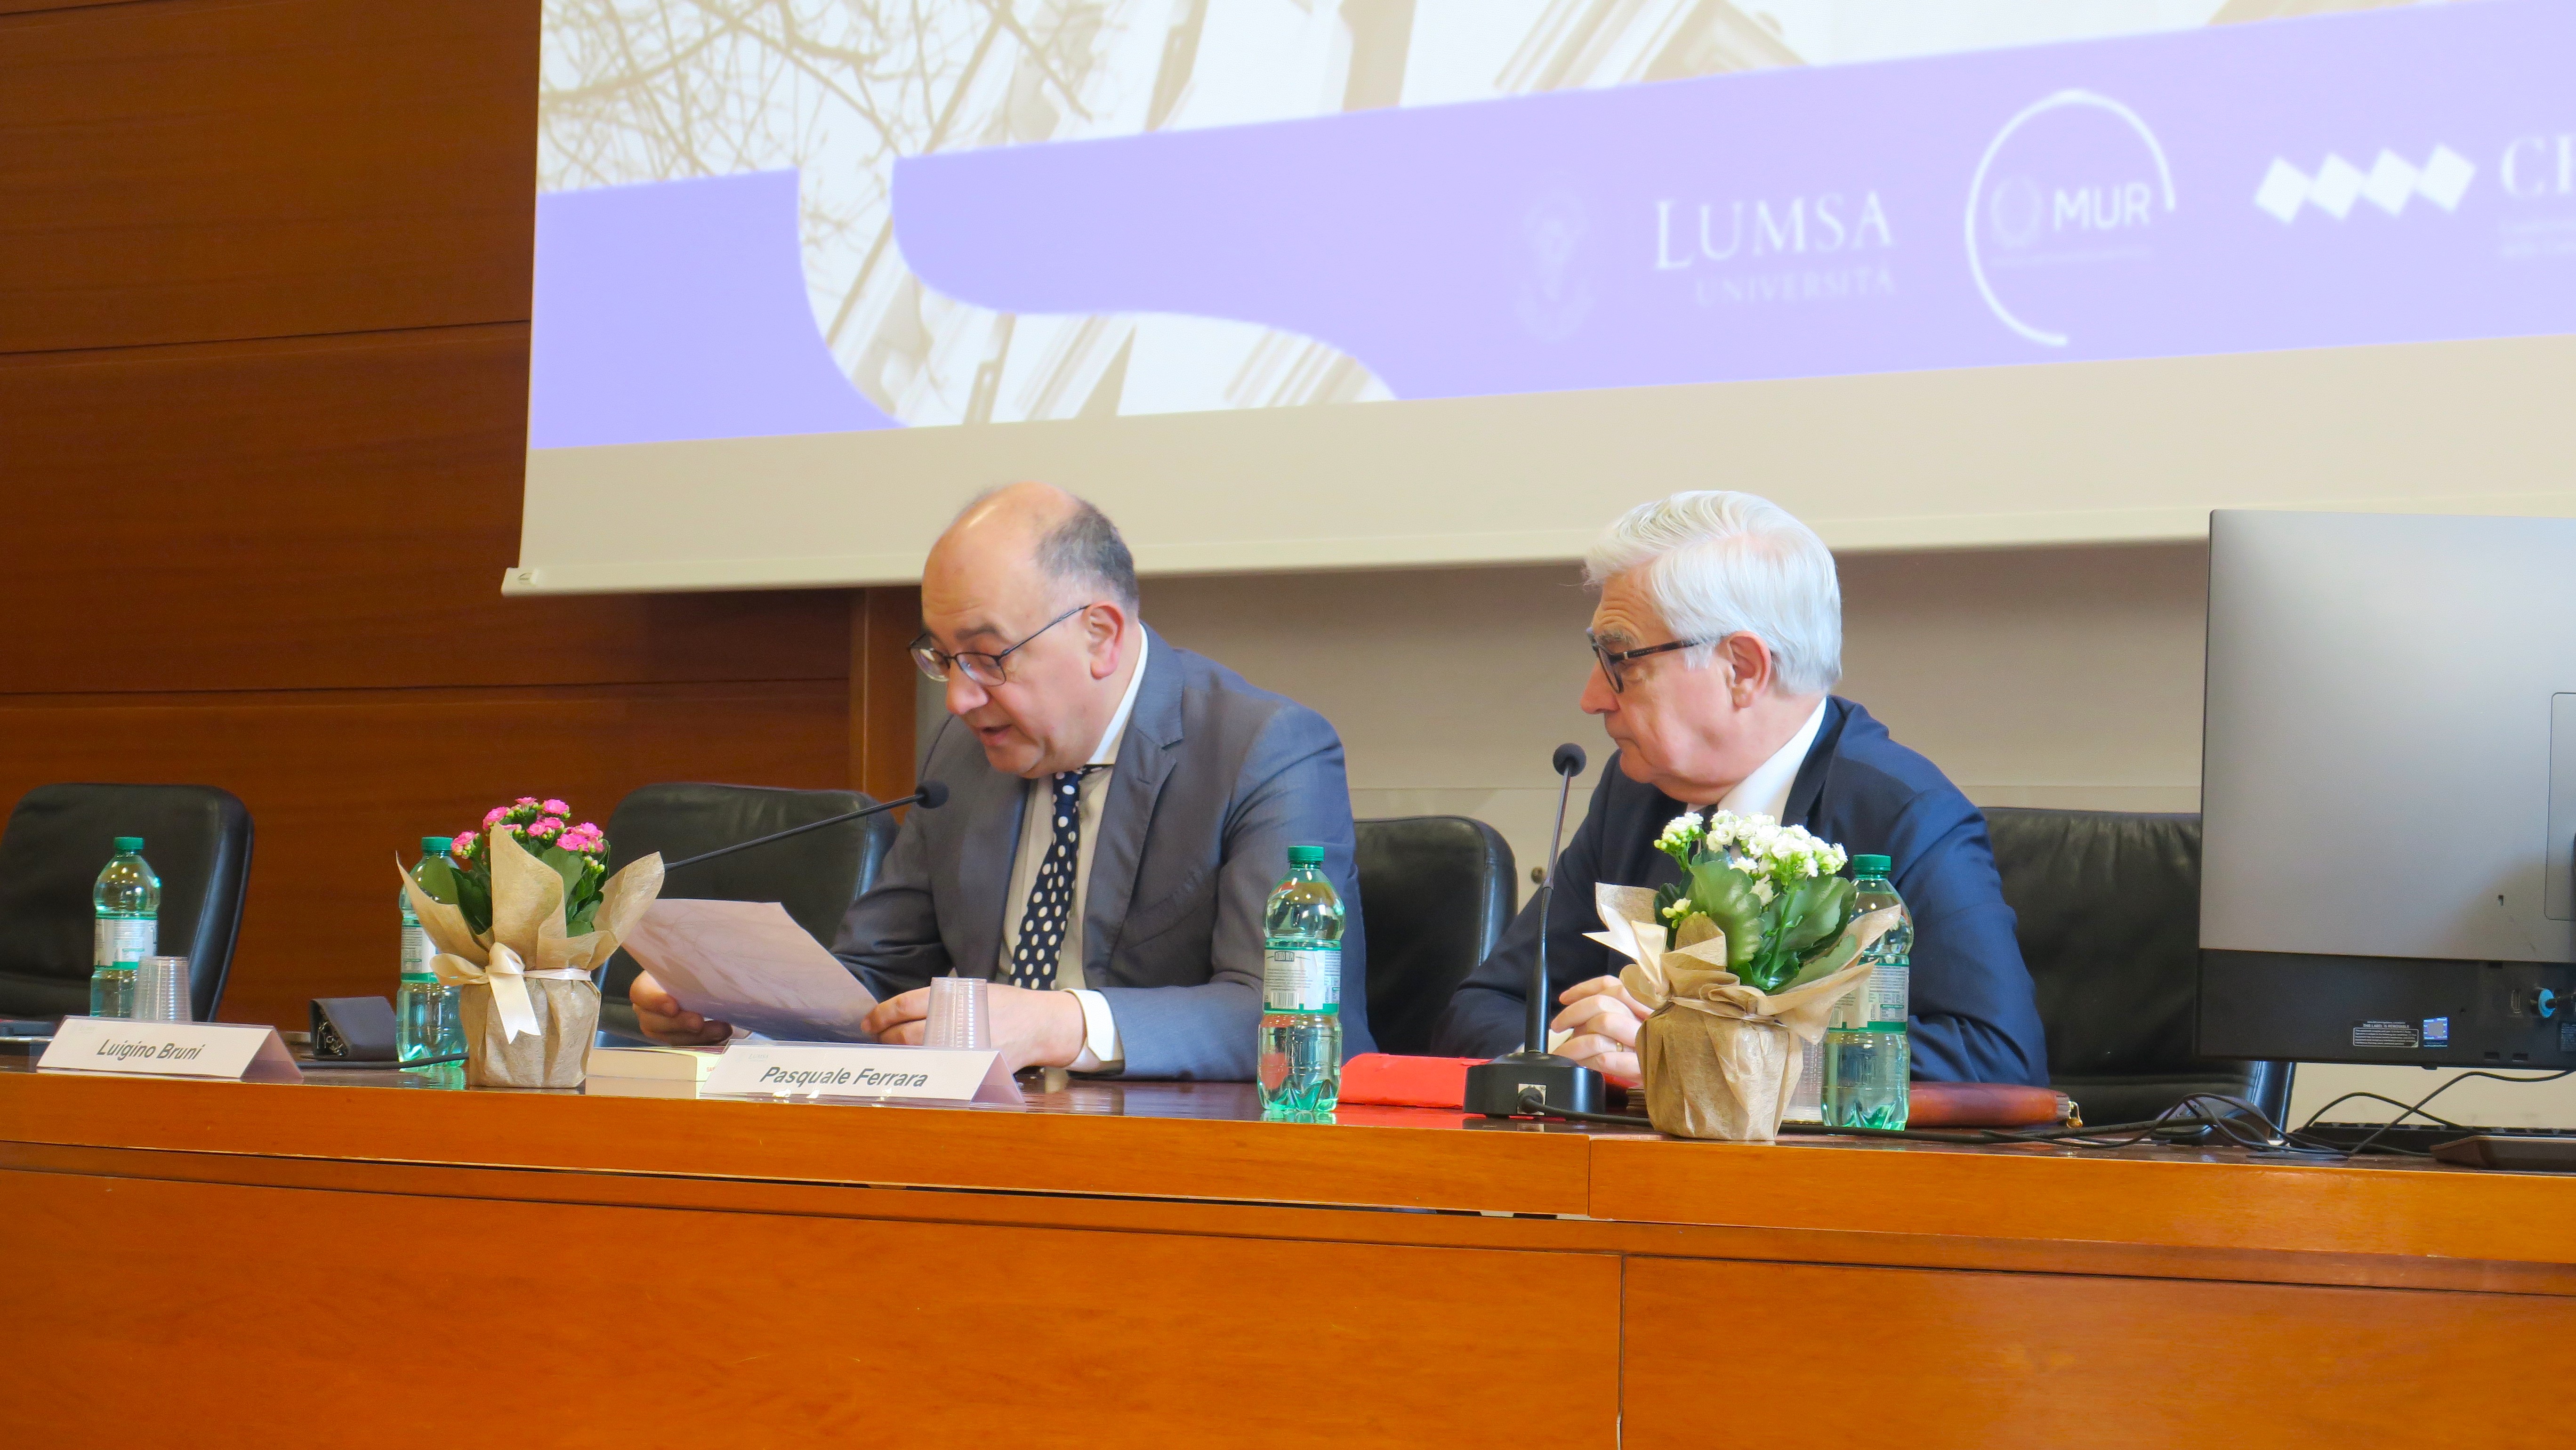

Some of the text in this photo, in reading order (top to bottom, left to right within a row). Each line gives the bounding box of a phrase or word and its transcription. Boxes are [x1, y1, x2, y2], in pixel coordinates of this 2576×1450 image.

[2054, 182, 2152, 232] MUR
[1656, 190, 1895, 270] LUMSA
[97, 1039, 206, 1061] Luigino Bruni
[759, 1067, 928, 1087] Pasquale Ferrara
